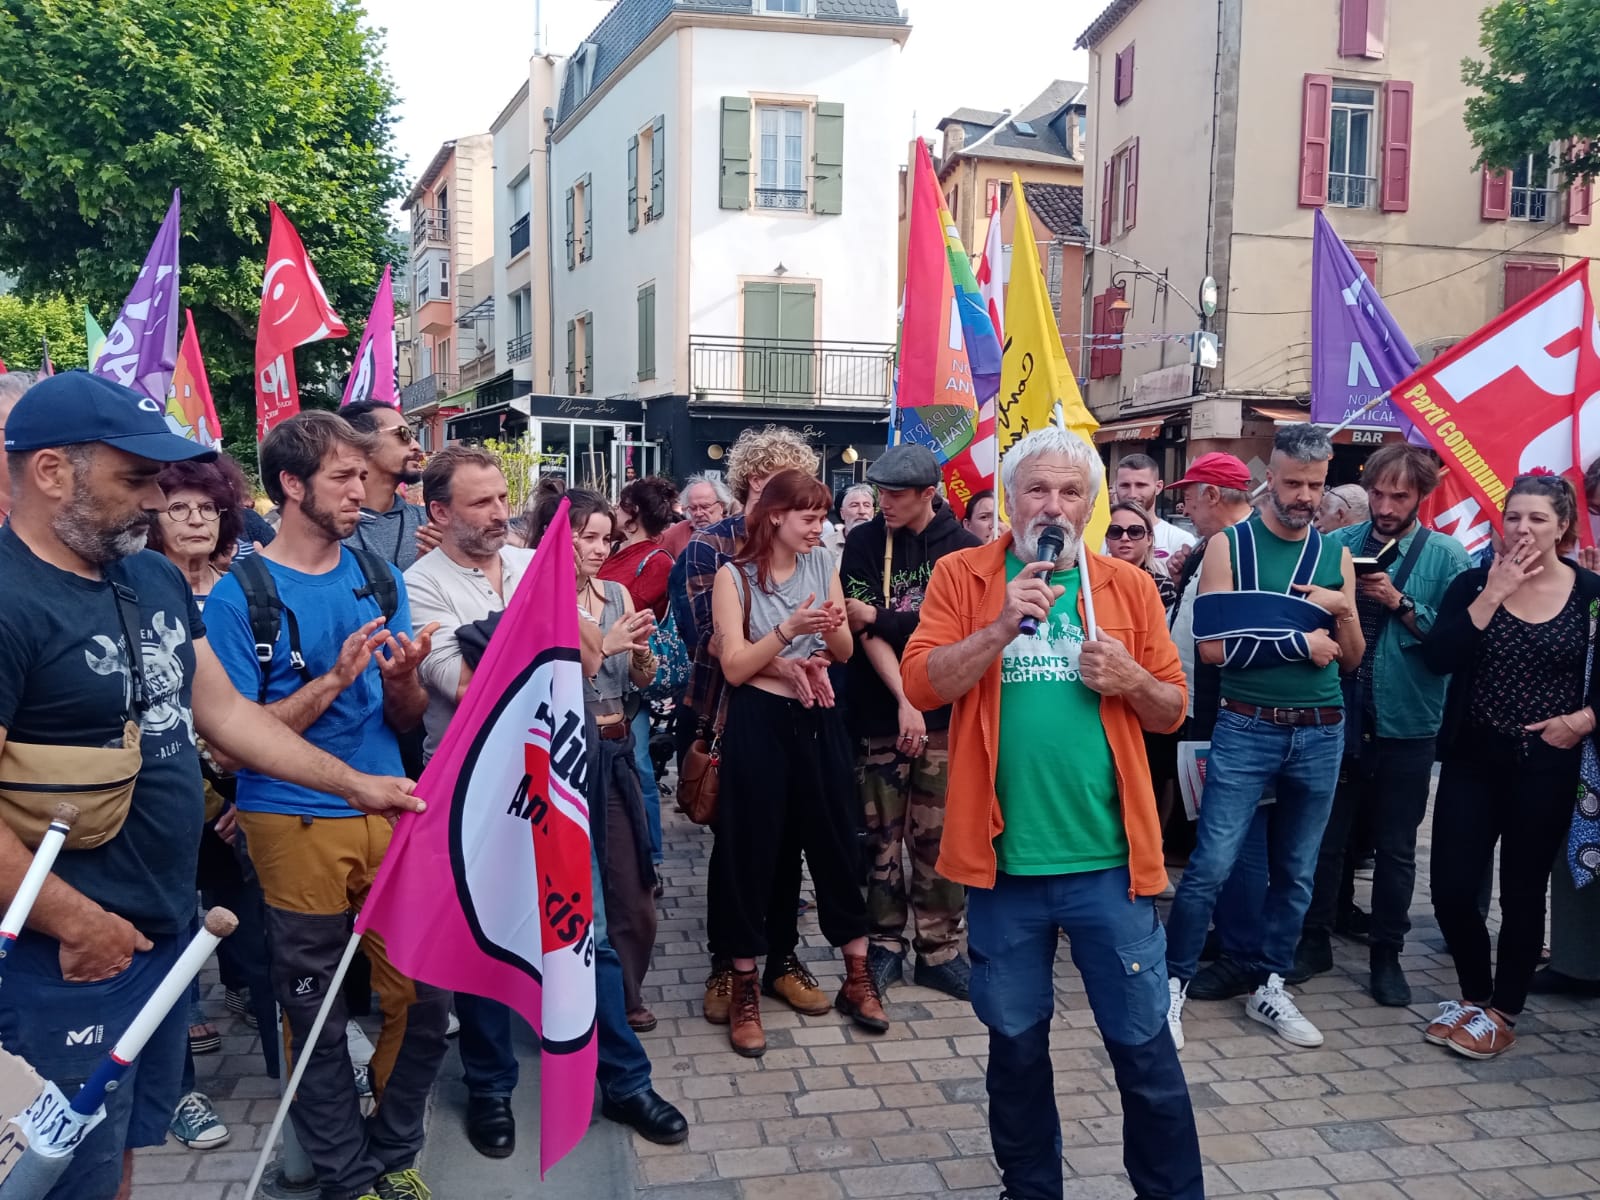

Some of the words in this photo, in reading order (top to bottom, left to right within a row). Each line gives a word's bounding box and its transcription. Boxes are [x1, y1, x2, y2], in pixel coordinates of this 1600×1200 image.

[1403, 383, 1450, 427] Parti
[1352, 431, 1383, 443] BAR
[1001, 656, 1069, 668] EASANTS
